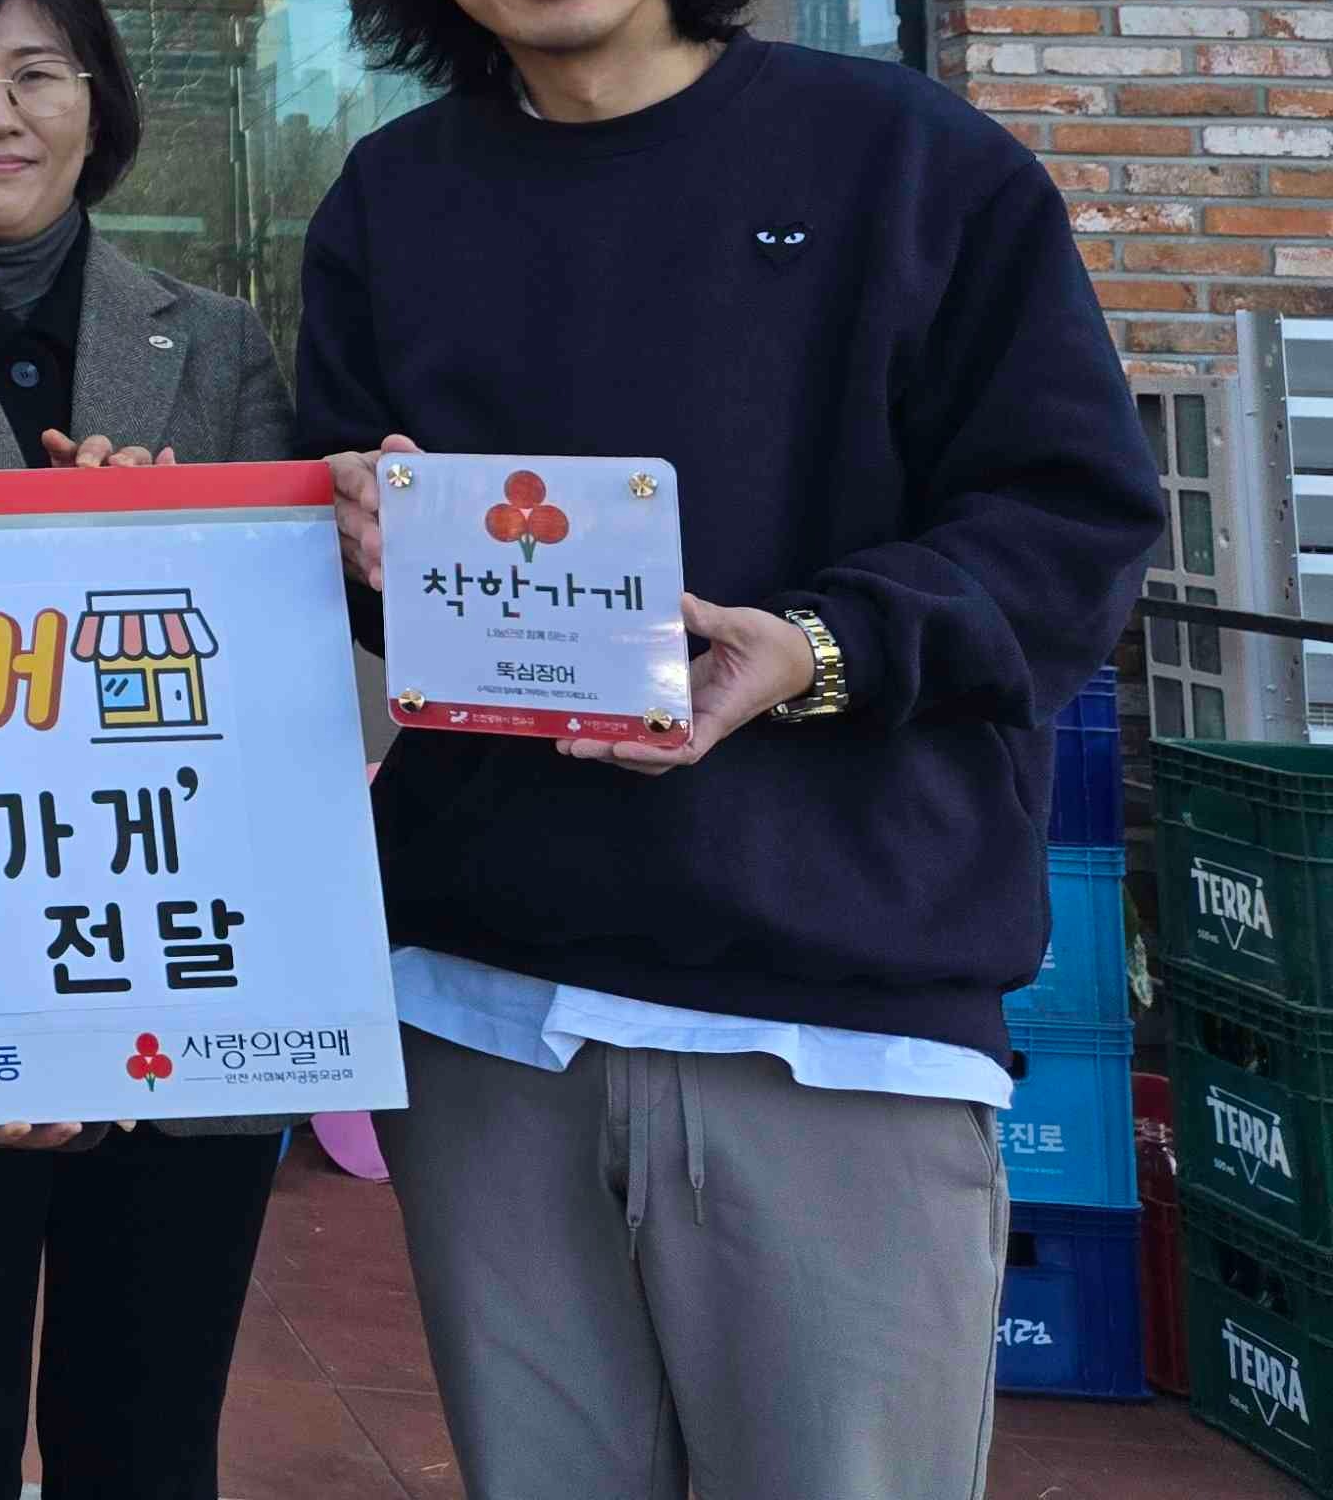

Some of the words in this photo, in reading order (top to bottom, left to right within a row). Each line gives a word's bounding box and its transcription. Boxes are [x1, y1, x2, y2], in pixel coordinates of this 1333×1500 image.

[422, 562, 644, 619] 착한가게
[496, 661, 575, 684] 뚝심장어
[1191, 867, 1274, 939] TERRA
[44, 898, 245, 995] 전달
[182, 1028, 351, 1070] 사랑의열매
[1206, 1095, 1292, 1178] TERRA
[1221, 1327, 1310, 1426] TERRA
